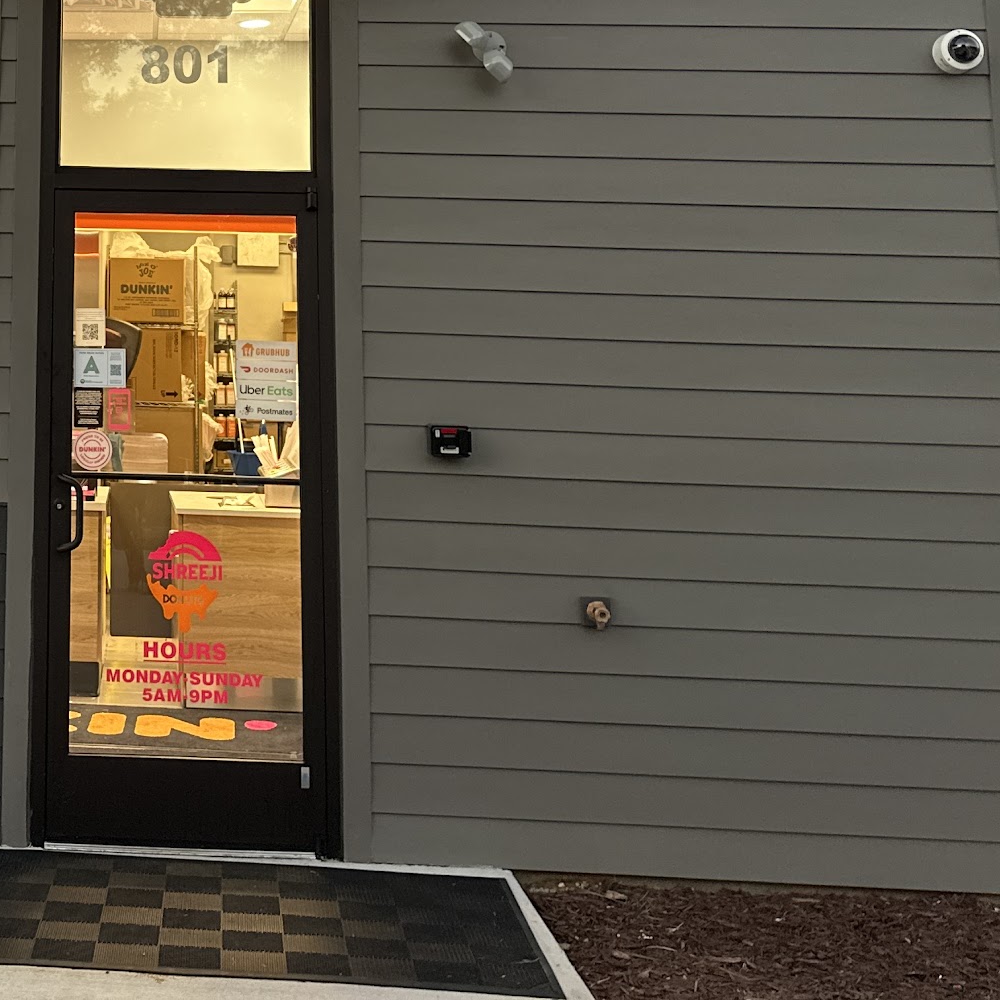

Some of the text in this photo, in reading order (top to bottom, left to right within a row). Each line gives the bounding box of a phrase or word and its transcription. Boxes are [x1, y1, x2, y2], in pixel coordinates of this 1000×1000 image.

[140, 44, 230, 85] 801
[120, 284, 173, 295] DUNKIN'
[255, 347, 291, 357] GRUBHUB
[82, 355, 100, 374] A
[253, 366, 294, 374] DOORDASH
[239, 384, 293, 397] Uber Eats
[256, 407, 293, 416] Postmates
[152, 562, 223, 581] SHREEJI
[143, 641, 227, 662] HOURS
